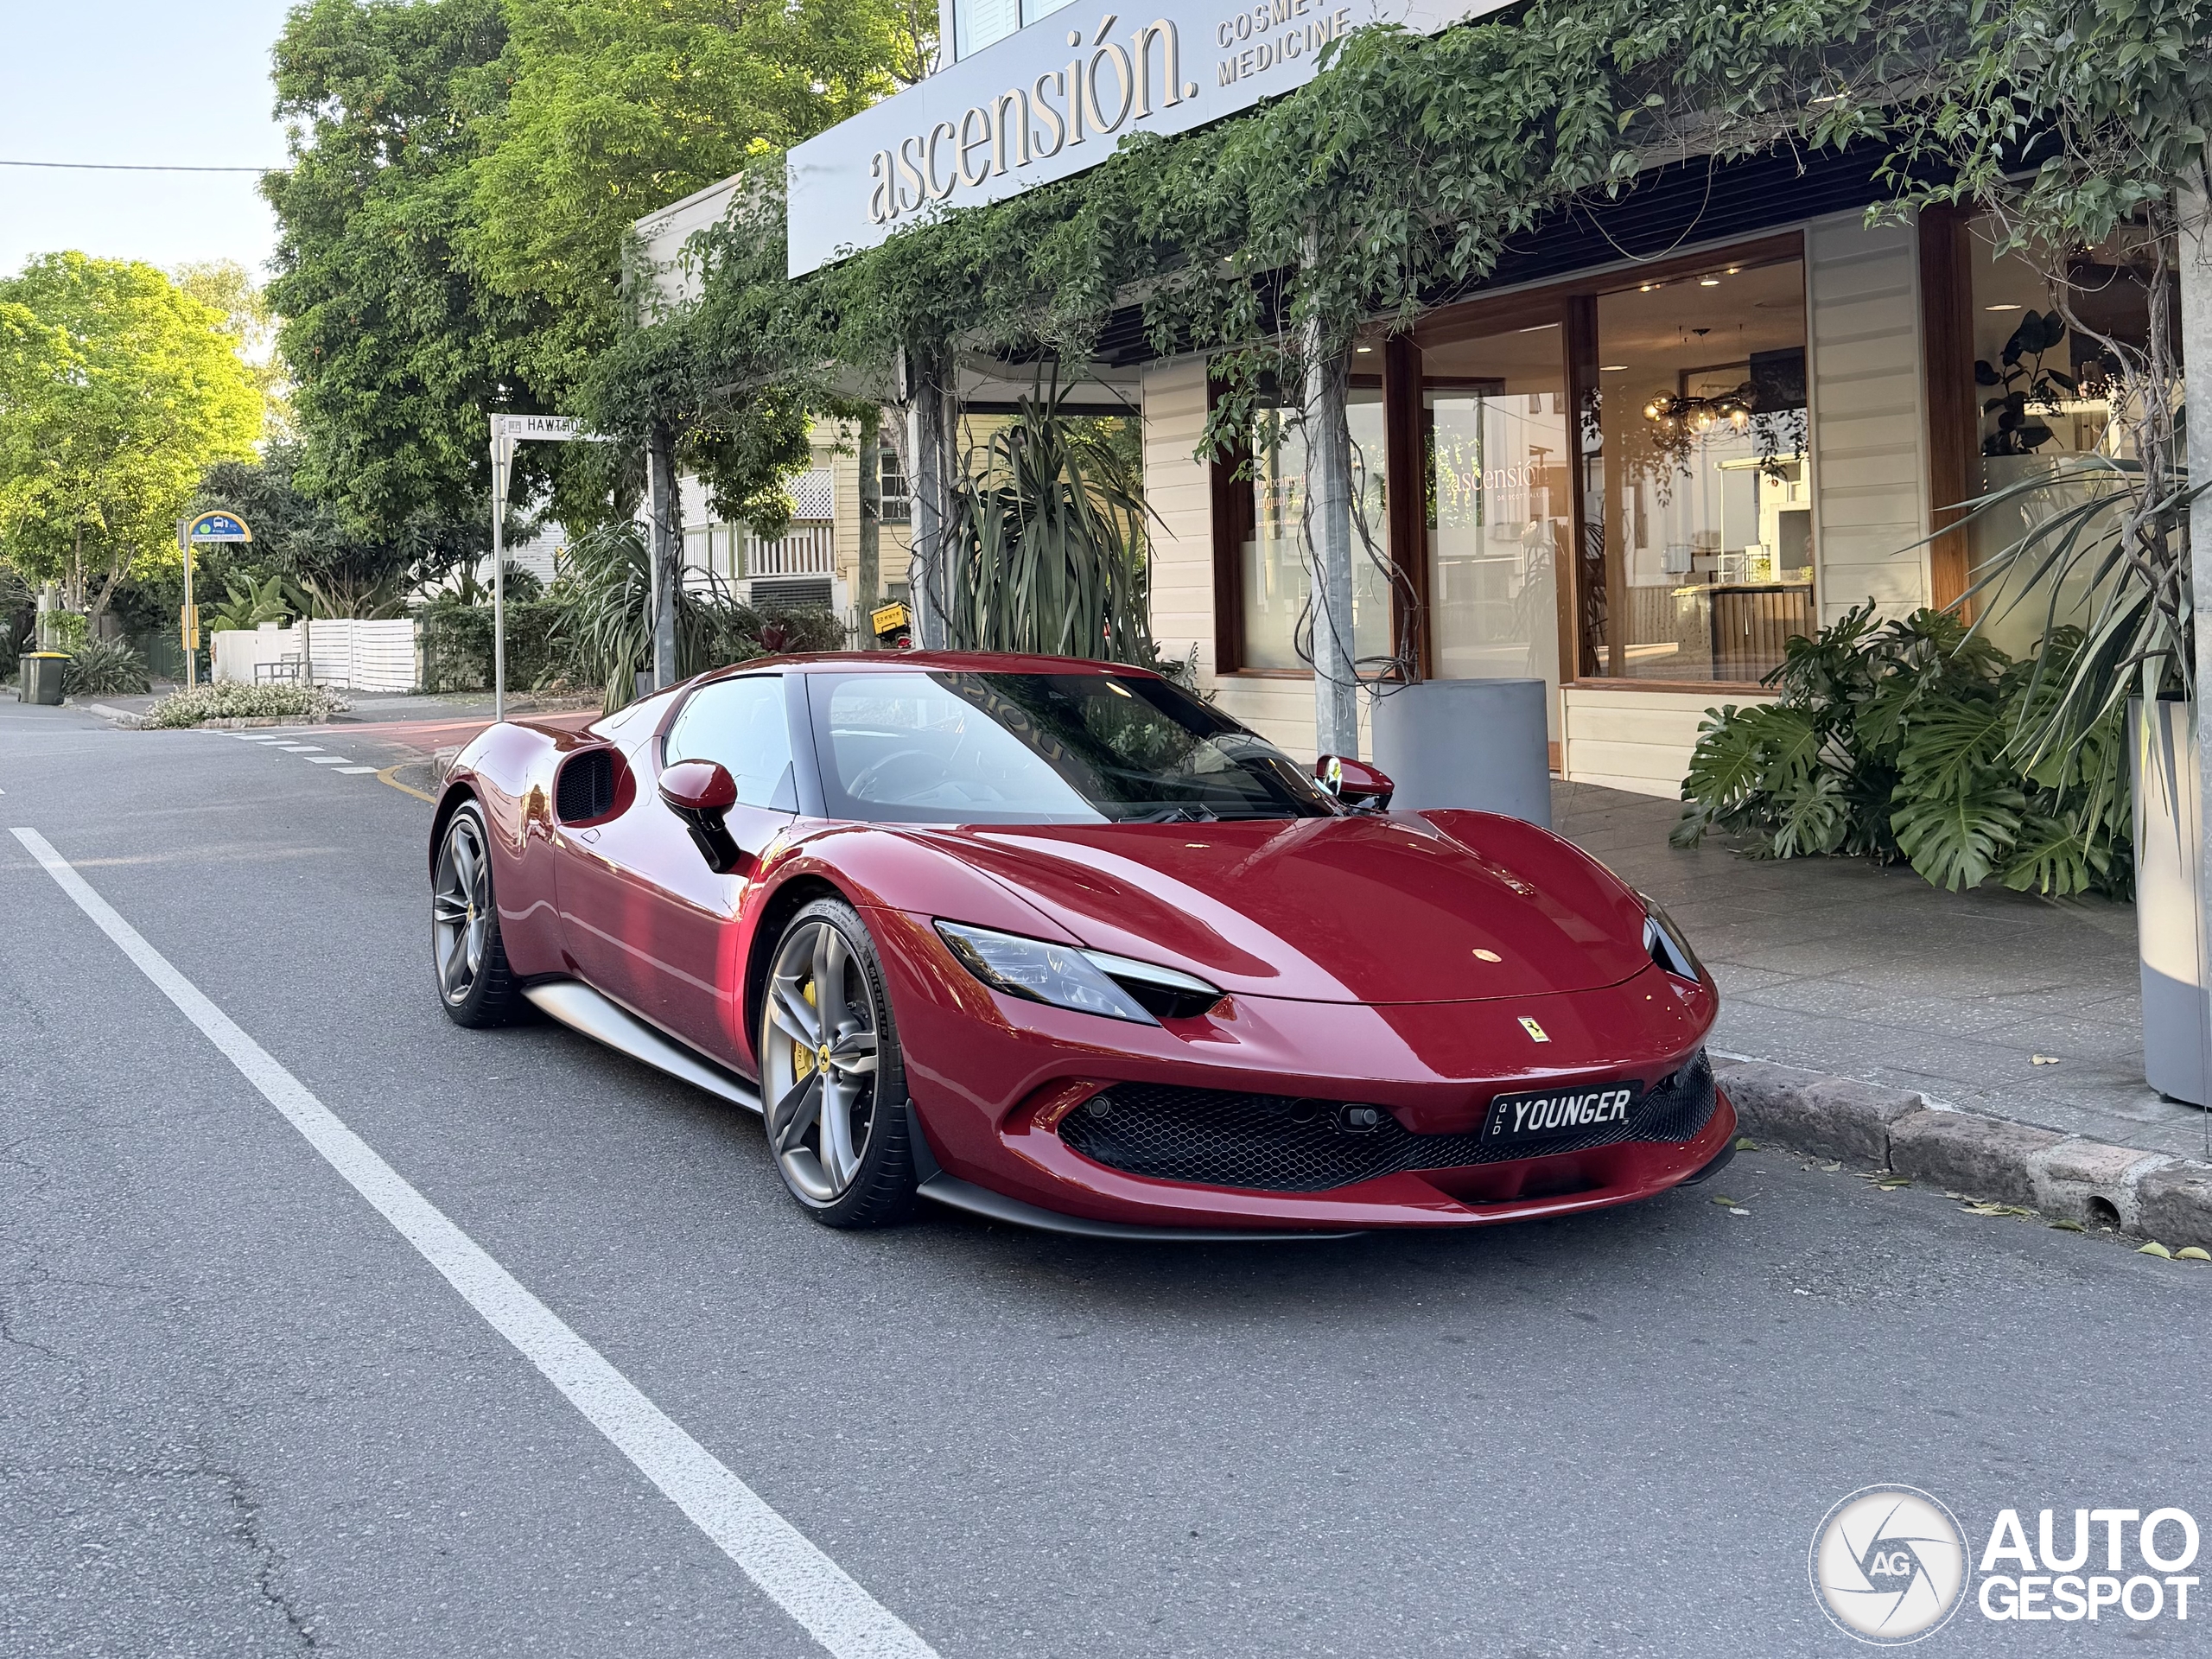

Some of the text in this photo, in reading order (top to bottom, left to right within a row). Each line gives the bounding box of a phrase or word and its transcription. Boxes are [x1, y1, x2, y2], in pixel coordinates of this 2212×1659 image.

[1216, 0, 1324, 48] COSME
[1217, 7, 1351, 87] MEDICINE
[528, 418, 588, 433] HAWTHO
[868, 967, 888, 1037] MICHELIN
[1492, 1103, 1508, 1135] QLD
[1516, 1090, 1631, 1133] YOUNGER
